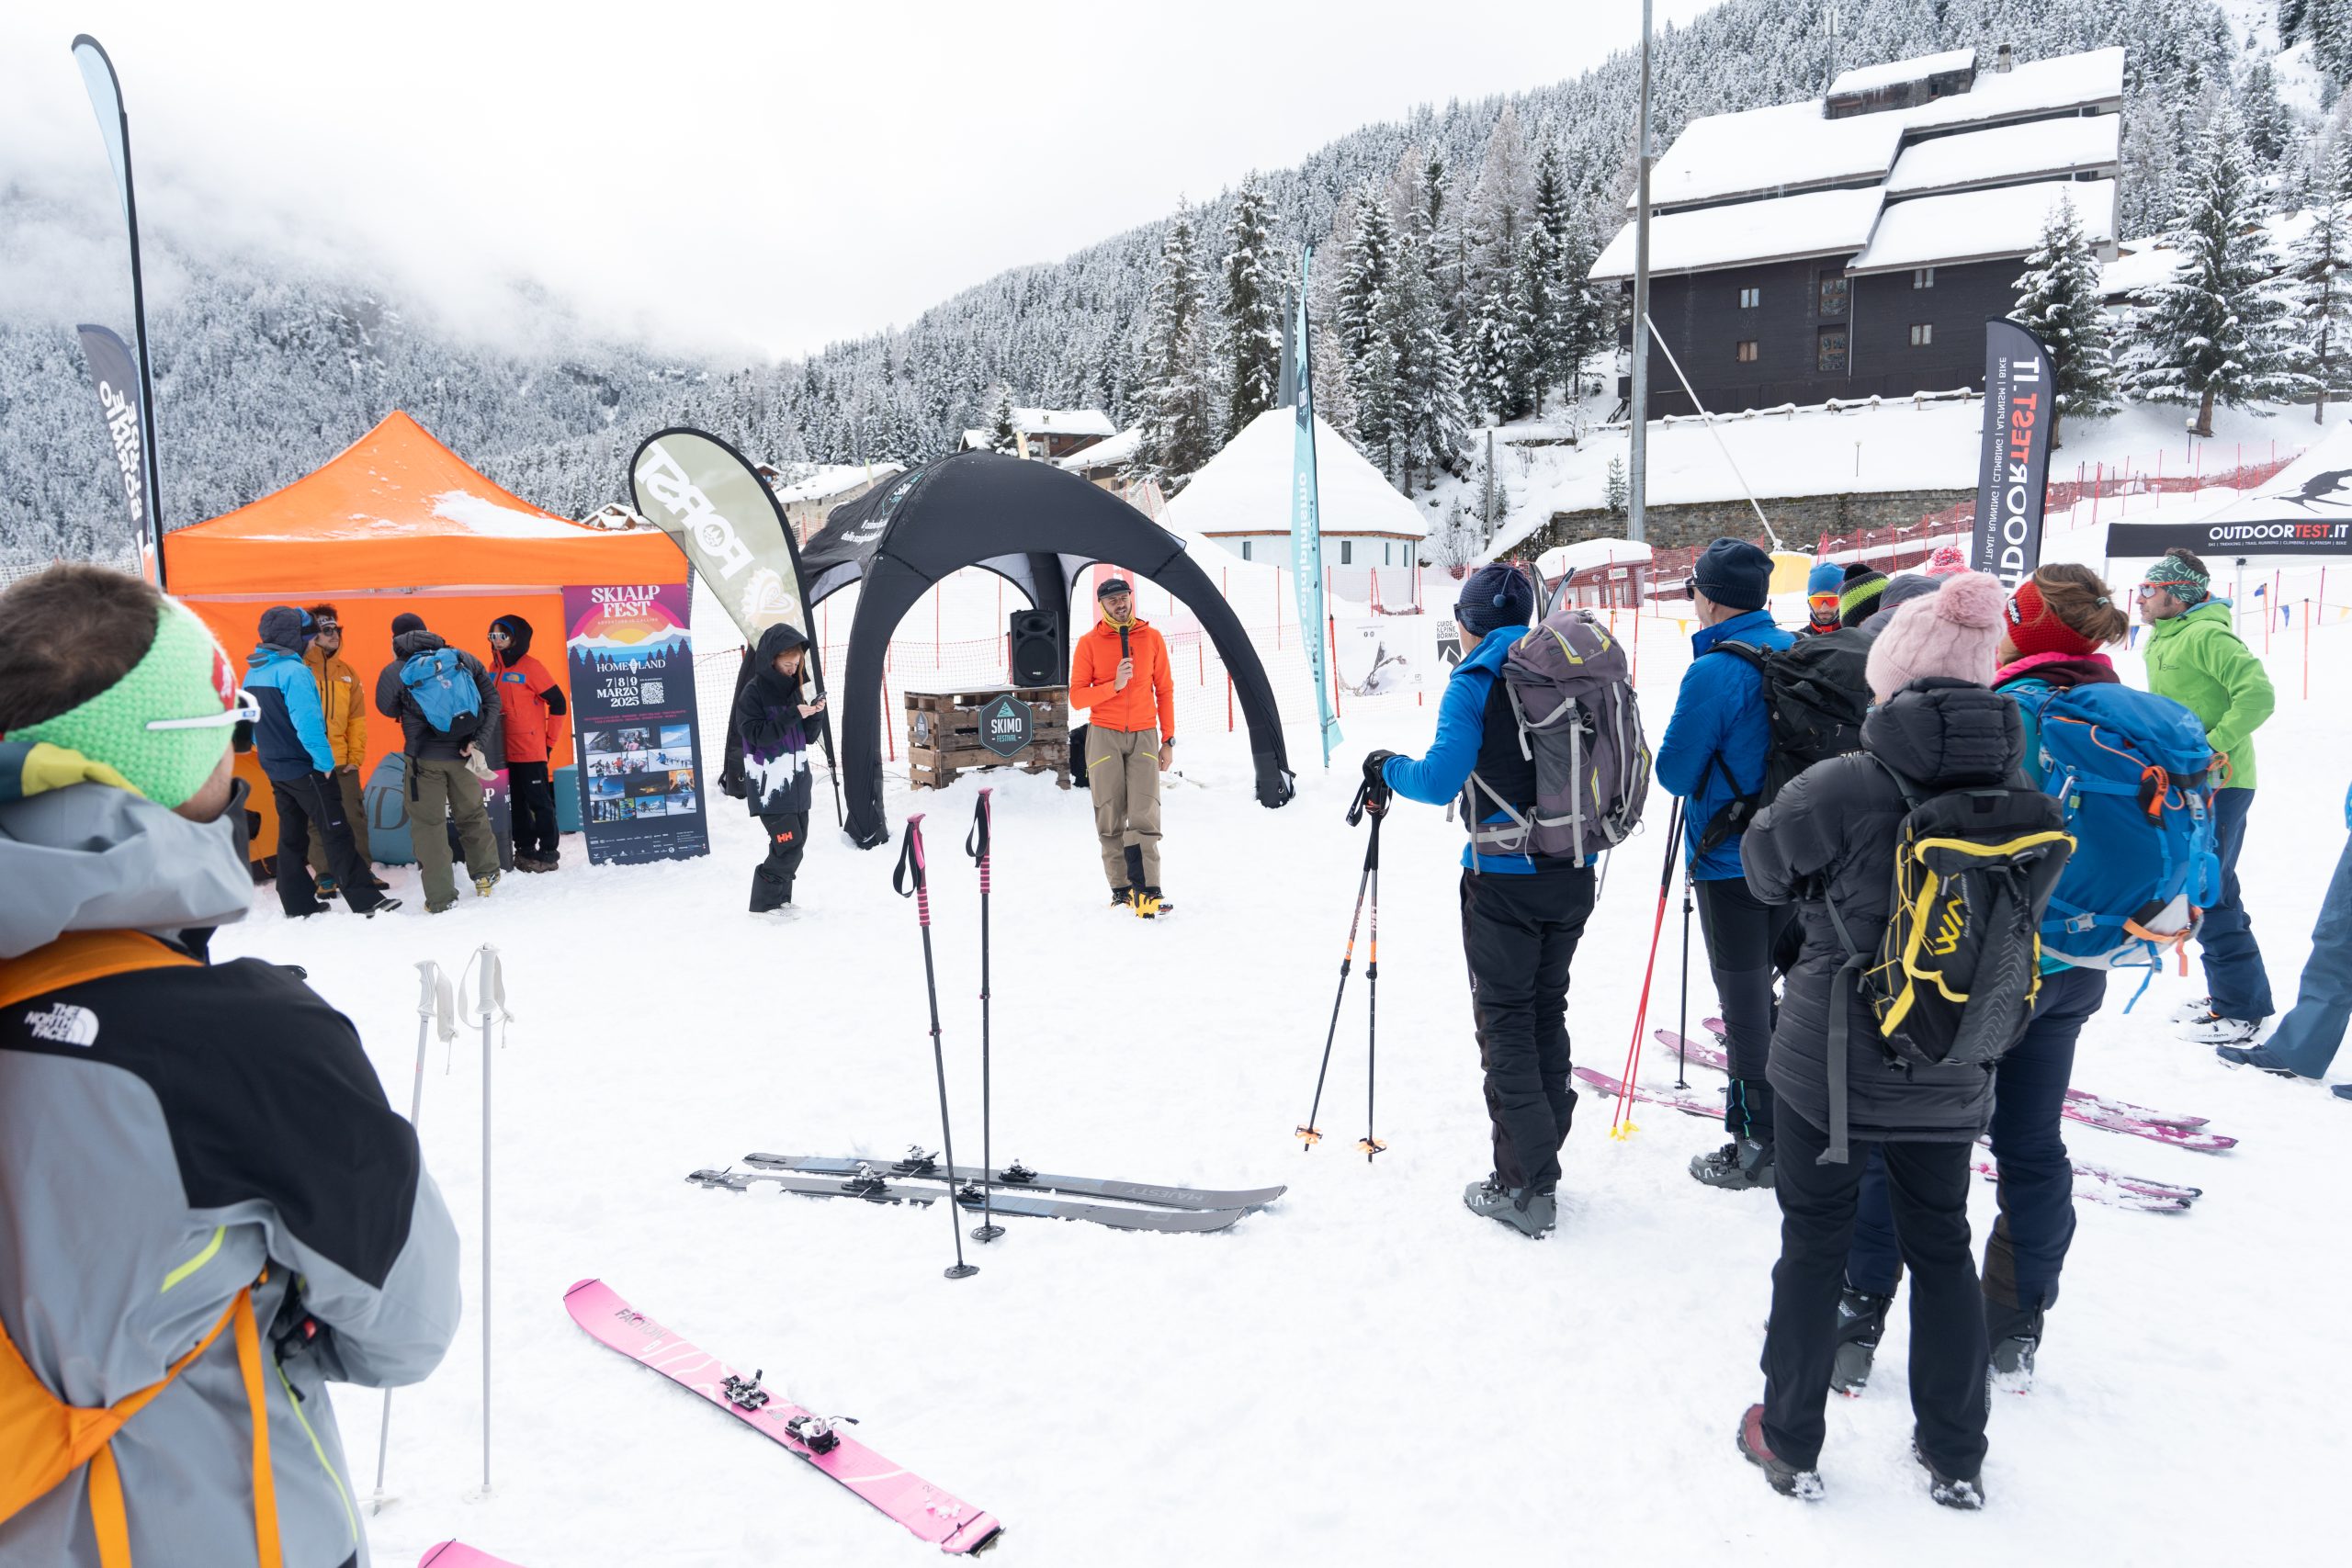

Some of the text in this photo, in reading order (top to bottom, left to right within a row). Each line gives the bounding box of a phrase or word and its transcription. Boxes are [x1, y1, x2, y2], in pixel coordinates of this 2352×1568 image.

[2209, 524, 2349, 540] OUTDOORTEST.IT
[591, 585, 661, 604] SKIALP
[603, 600, 650, 618] FEST
[596, 687, 639, 698] MARZO
[610, 696, 640, 707] 2025
[991, 717, 1023, 734] SKIMO
[52, 1002, 79, 1017] THE
[24, 1010, 73, 1030] NORTH
[31, 1022, 70, 1042] FACE
[1126, 1187, 1204, 1201] MAJESTY
